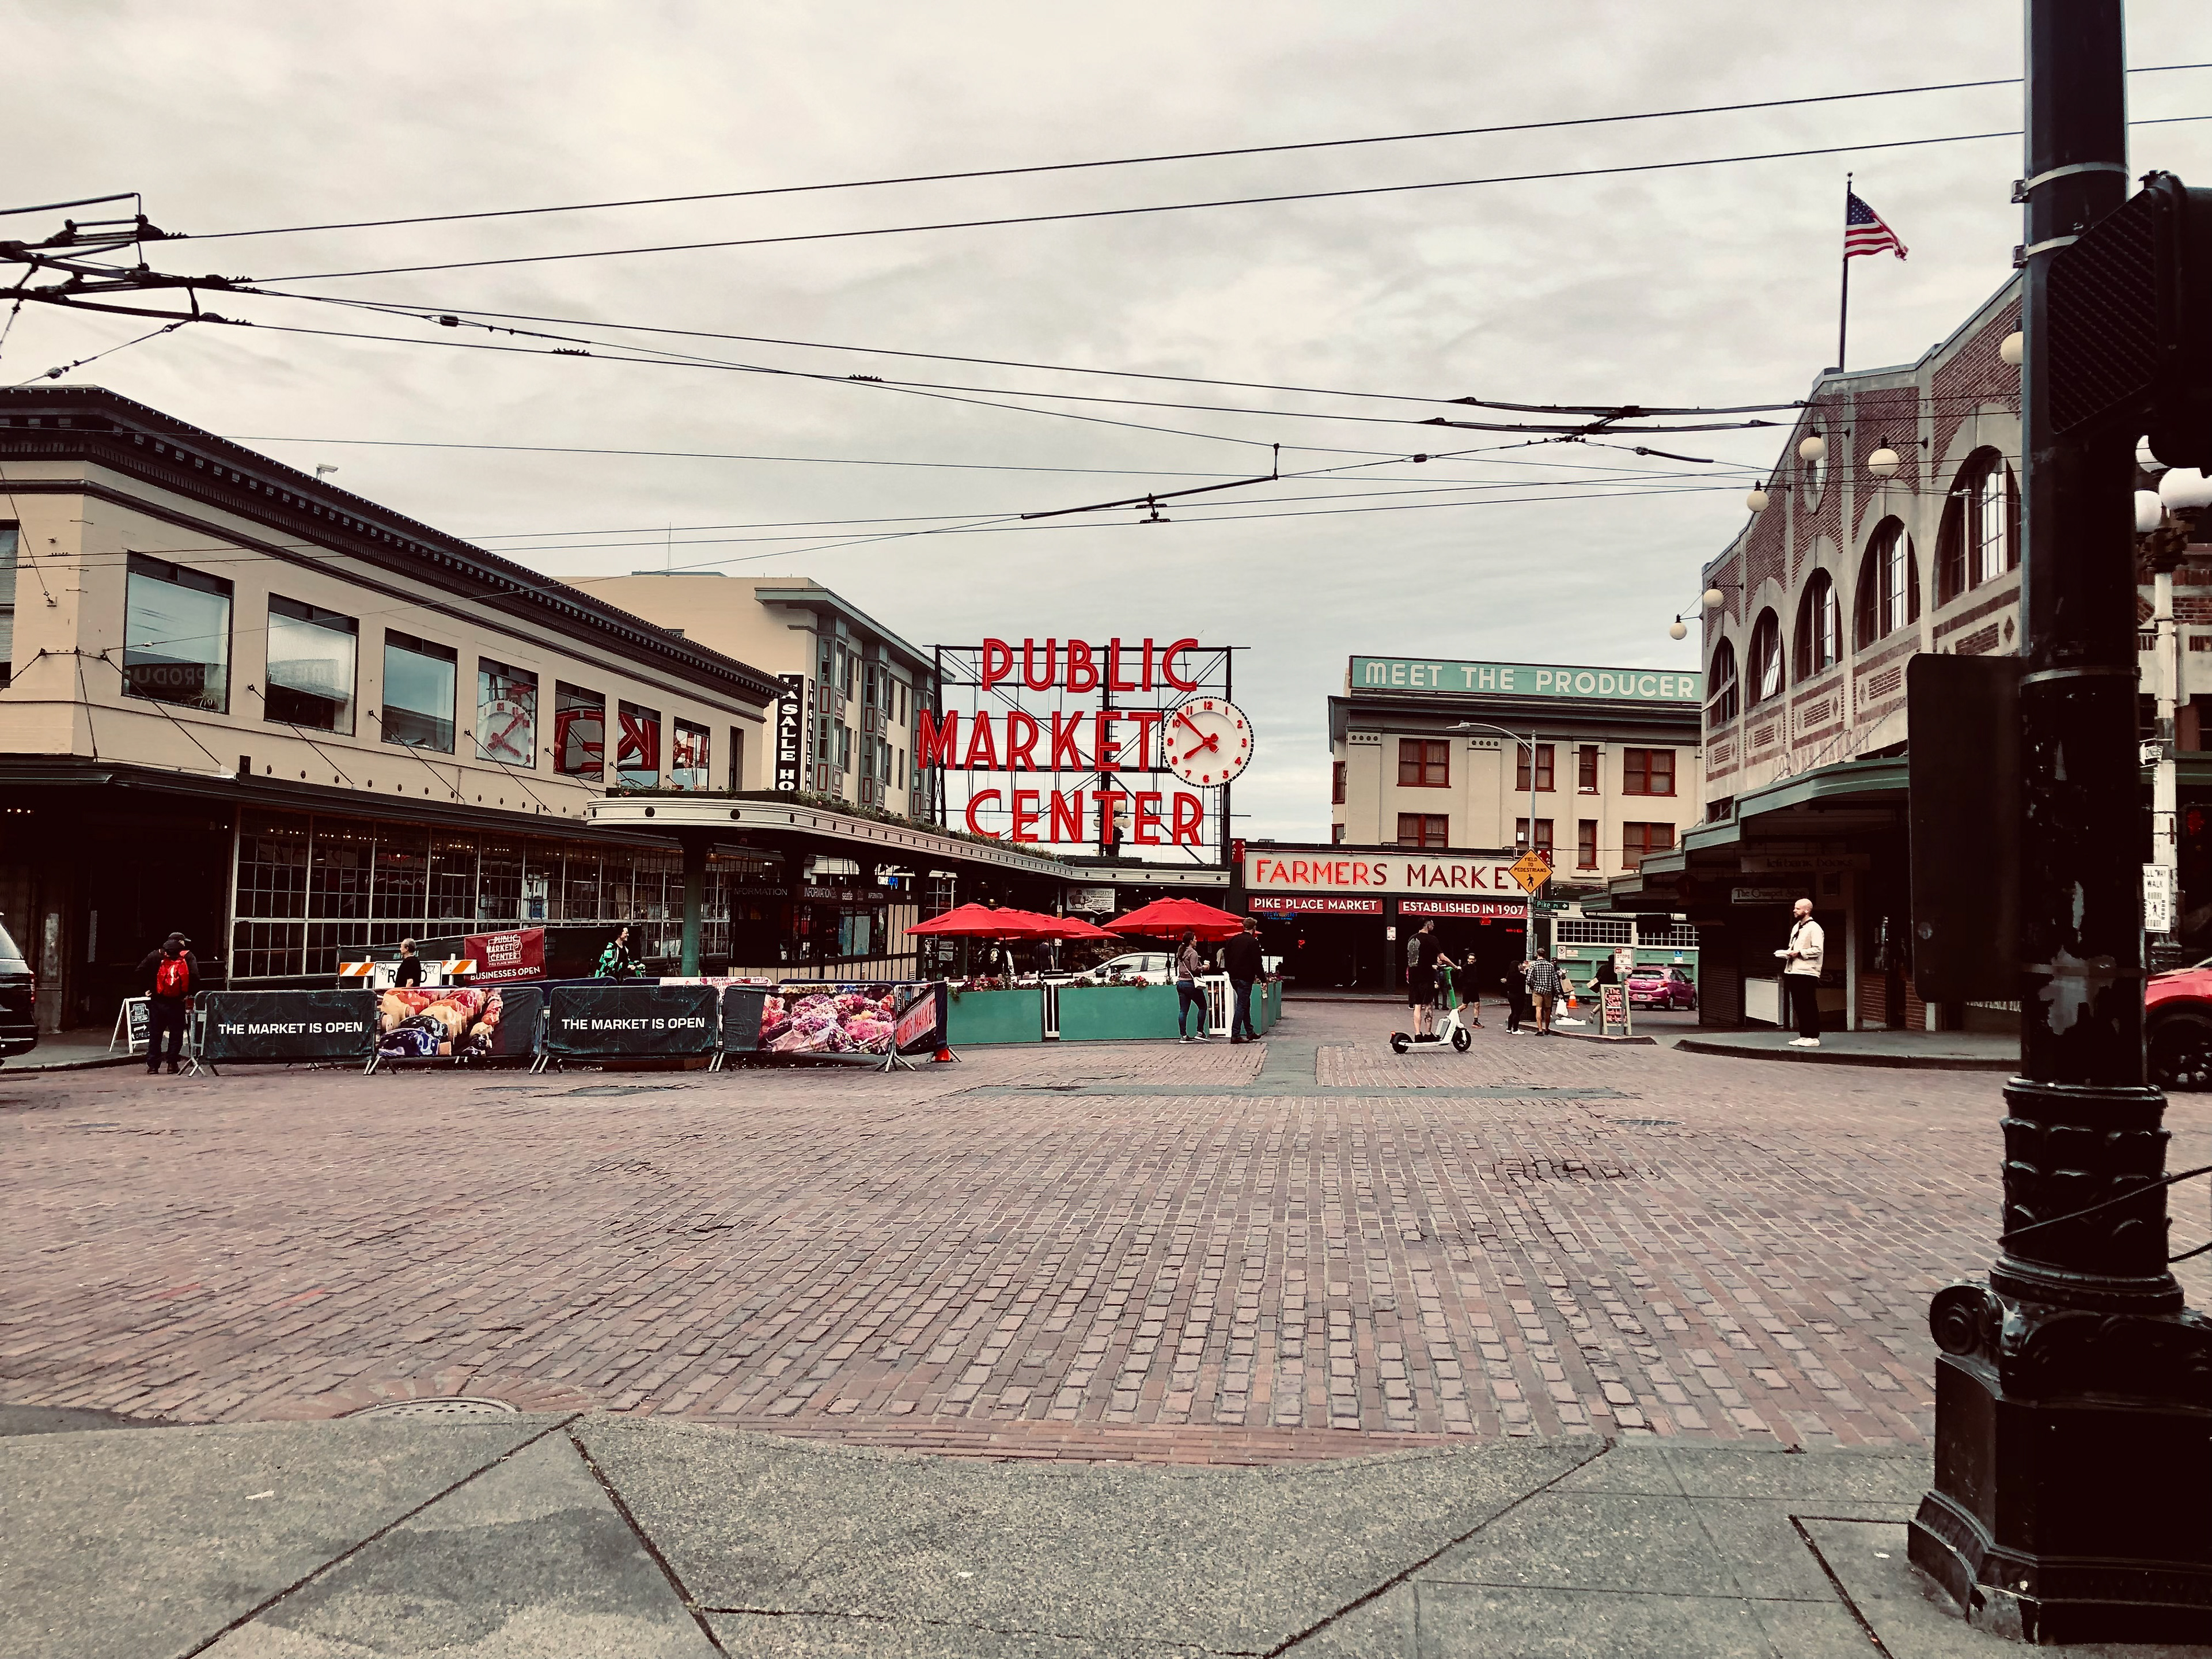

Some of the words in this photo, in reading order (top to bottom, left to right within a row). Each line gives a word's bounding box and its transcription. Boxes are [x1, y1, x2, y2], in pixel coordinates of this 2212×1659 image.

[982, 638, 1199, 693] PUBLIC
[1365, 661, 1443, 687] MEET
[1461, 666, 1514, 690] THE
[1535, 671, 1695, 698] PRODUCER
[1186, 706, 1193, 715] 11
[1204, 701, 1213, 710] 12
[1225, 706, 1228, 715] 1
[1172, 719, 1181, 728] 10
[1237, 719, 1243, 729] 2
[780, 704, 798, 762] SALLE
[918, 709, 1163, 771] MARKET
[1241, 738, 1247, 747] 3
[1172, 756, 1178, 764] 8
[1234, 757, 1242, 766] 4
[1185, 770, 1191, 778] 7
[1203, 775, 1209, 783] 6
[1222, 770, 1229, 778] 5
[965, 789, 1203, 845] CENTER
[1256, 859, 1388, 887] FARMERS
[1407, 863, 1521, 890] MARKE
[1736, 889, 1749, 898] The
[1254, 897, 1281, 908] PIKE
[1286, 899, 1324, 910] PLACE
[1328, 900, 1377, 911] MARKET
[1403, 902, 1480, 914] ESTABLISHED
[1482, 904, 1494, 914] IN
[1498, 905, 1525, 915] 1907
[494, 934, 518, 944] PUBLIC
[486, 943, 513, 953] MARKET
[490, 952, 517, 961] CENTER
[387, 969, 427, 983] RD
[470, 969, 517, 980] BUSINESSES
[518, 966, 540, 975] OPEN
[218, 1024, 244, 1035] THE
[248, 1023, 306, 1035] MARKET
[309, 1022, 322, 1033] IS
[325, 1021, 363, 1033] OPEN
[562, 1019, 588, 1030] THE
[592, 1018, 649, 1030] MARKET
[652, 1018, 664, 1029] IS
[668, 1017, 705, 1029] OPEN
